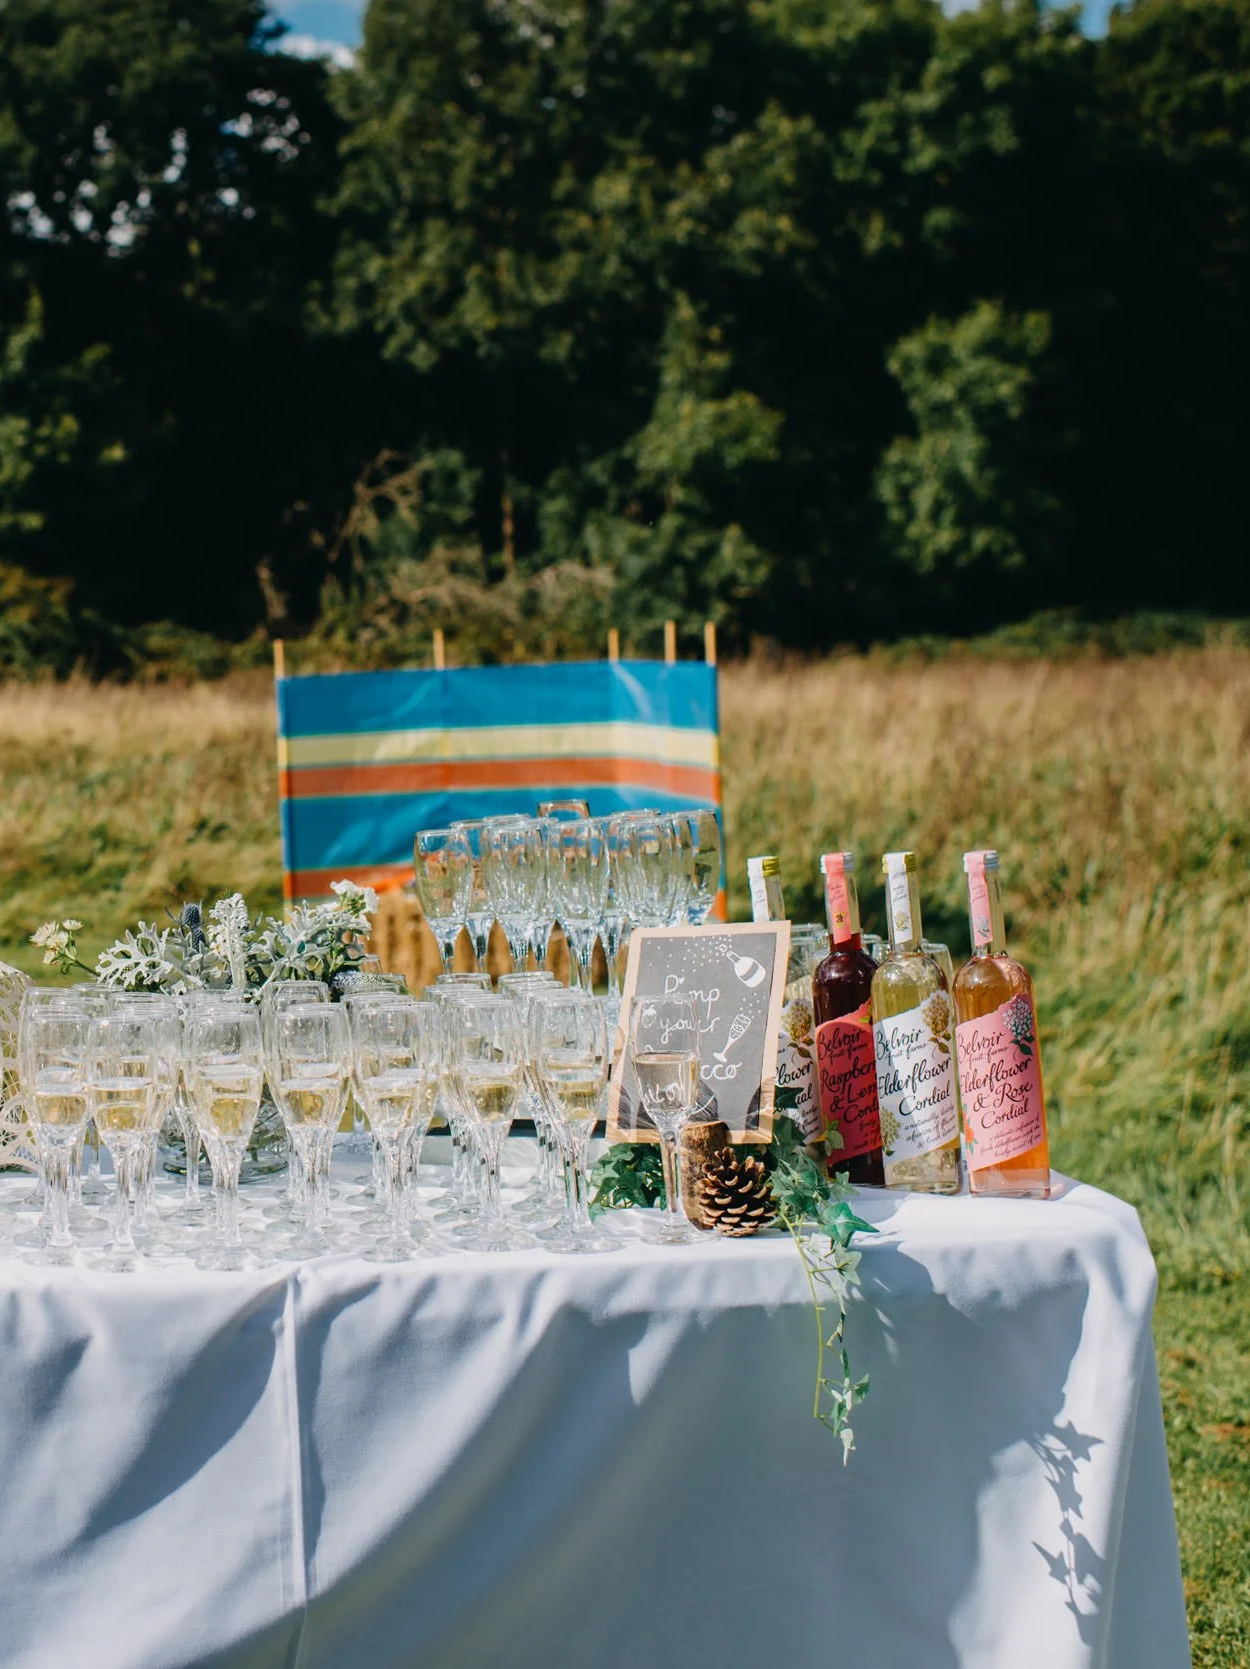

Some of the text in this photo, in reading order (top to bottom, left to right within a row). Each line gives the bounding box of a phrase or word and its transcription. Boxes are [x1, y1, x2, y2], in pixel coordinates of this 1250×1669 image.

[660, 1017, 720, 1044] your
[818, 1026, 866, 1060] Belvoir
[875, 1027, 924, 1060] Belvoir
[958, 1030, 1005, 1063] Belvoir
[906, 1043, 927, 1060] farms
[877, 1057, 952, 1099] Elderflower
[959, 1058, 1032, 1097] Elderflower
[830, 1093, 845, 1112] &
[899, 1080, 951, 1116] Cordial
[973, 1081, 1033, 1112] & Rose
[981, 1097, 1030, 1128] Cordial
